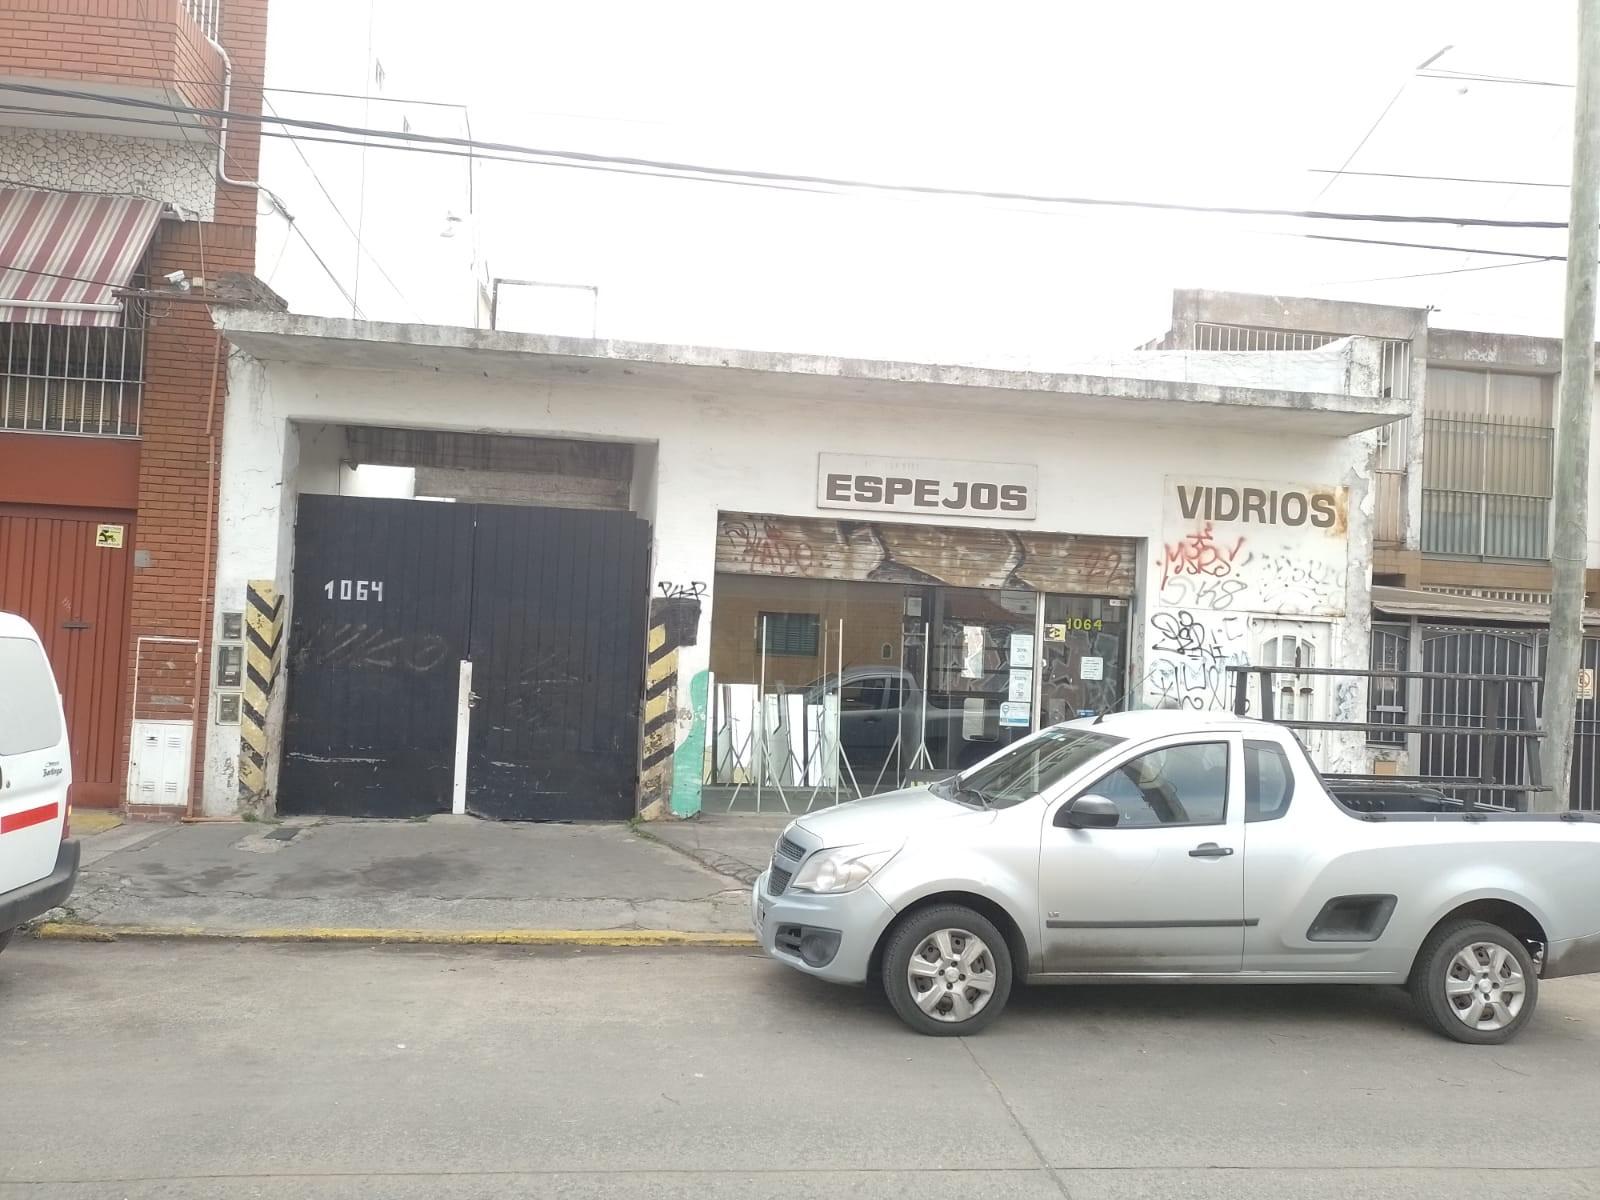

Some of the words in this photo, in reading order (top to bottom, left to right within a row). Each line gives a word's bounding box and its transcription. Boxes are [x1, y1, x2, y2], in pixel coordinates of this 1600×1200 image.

[826, 473, 1028, 512] ESPEJOS
[1176, 485, 1336, 528] VIDRIOS
[324, 579, 383, 602] 1064
[1066, 618, 1103, 631] 1064
